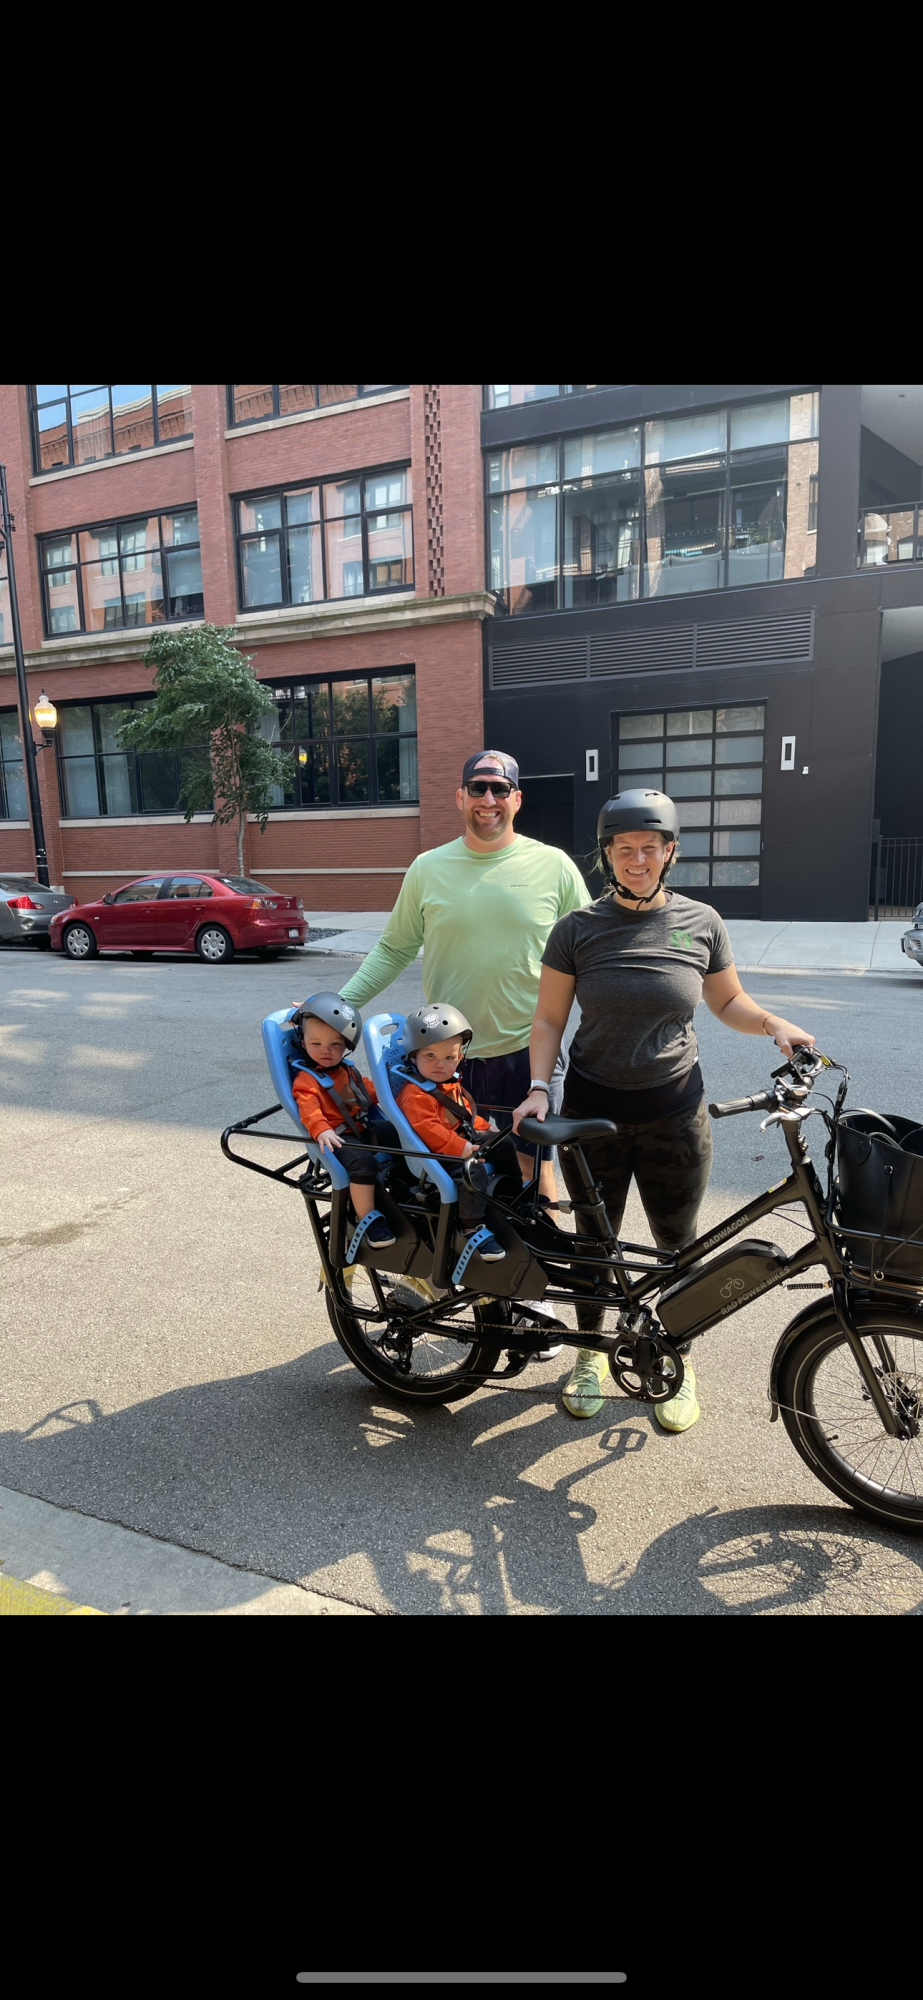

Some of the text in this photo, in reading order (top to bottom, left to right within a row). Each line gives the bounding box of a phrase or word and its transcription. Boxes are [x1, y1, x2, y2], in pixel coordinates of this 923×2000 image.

[703, 1214, 750, 1250] RADWAGON
[720, 1266, 791, 1316] RAD POWER BIKES
